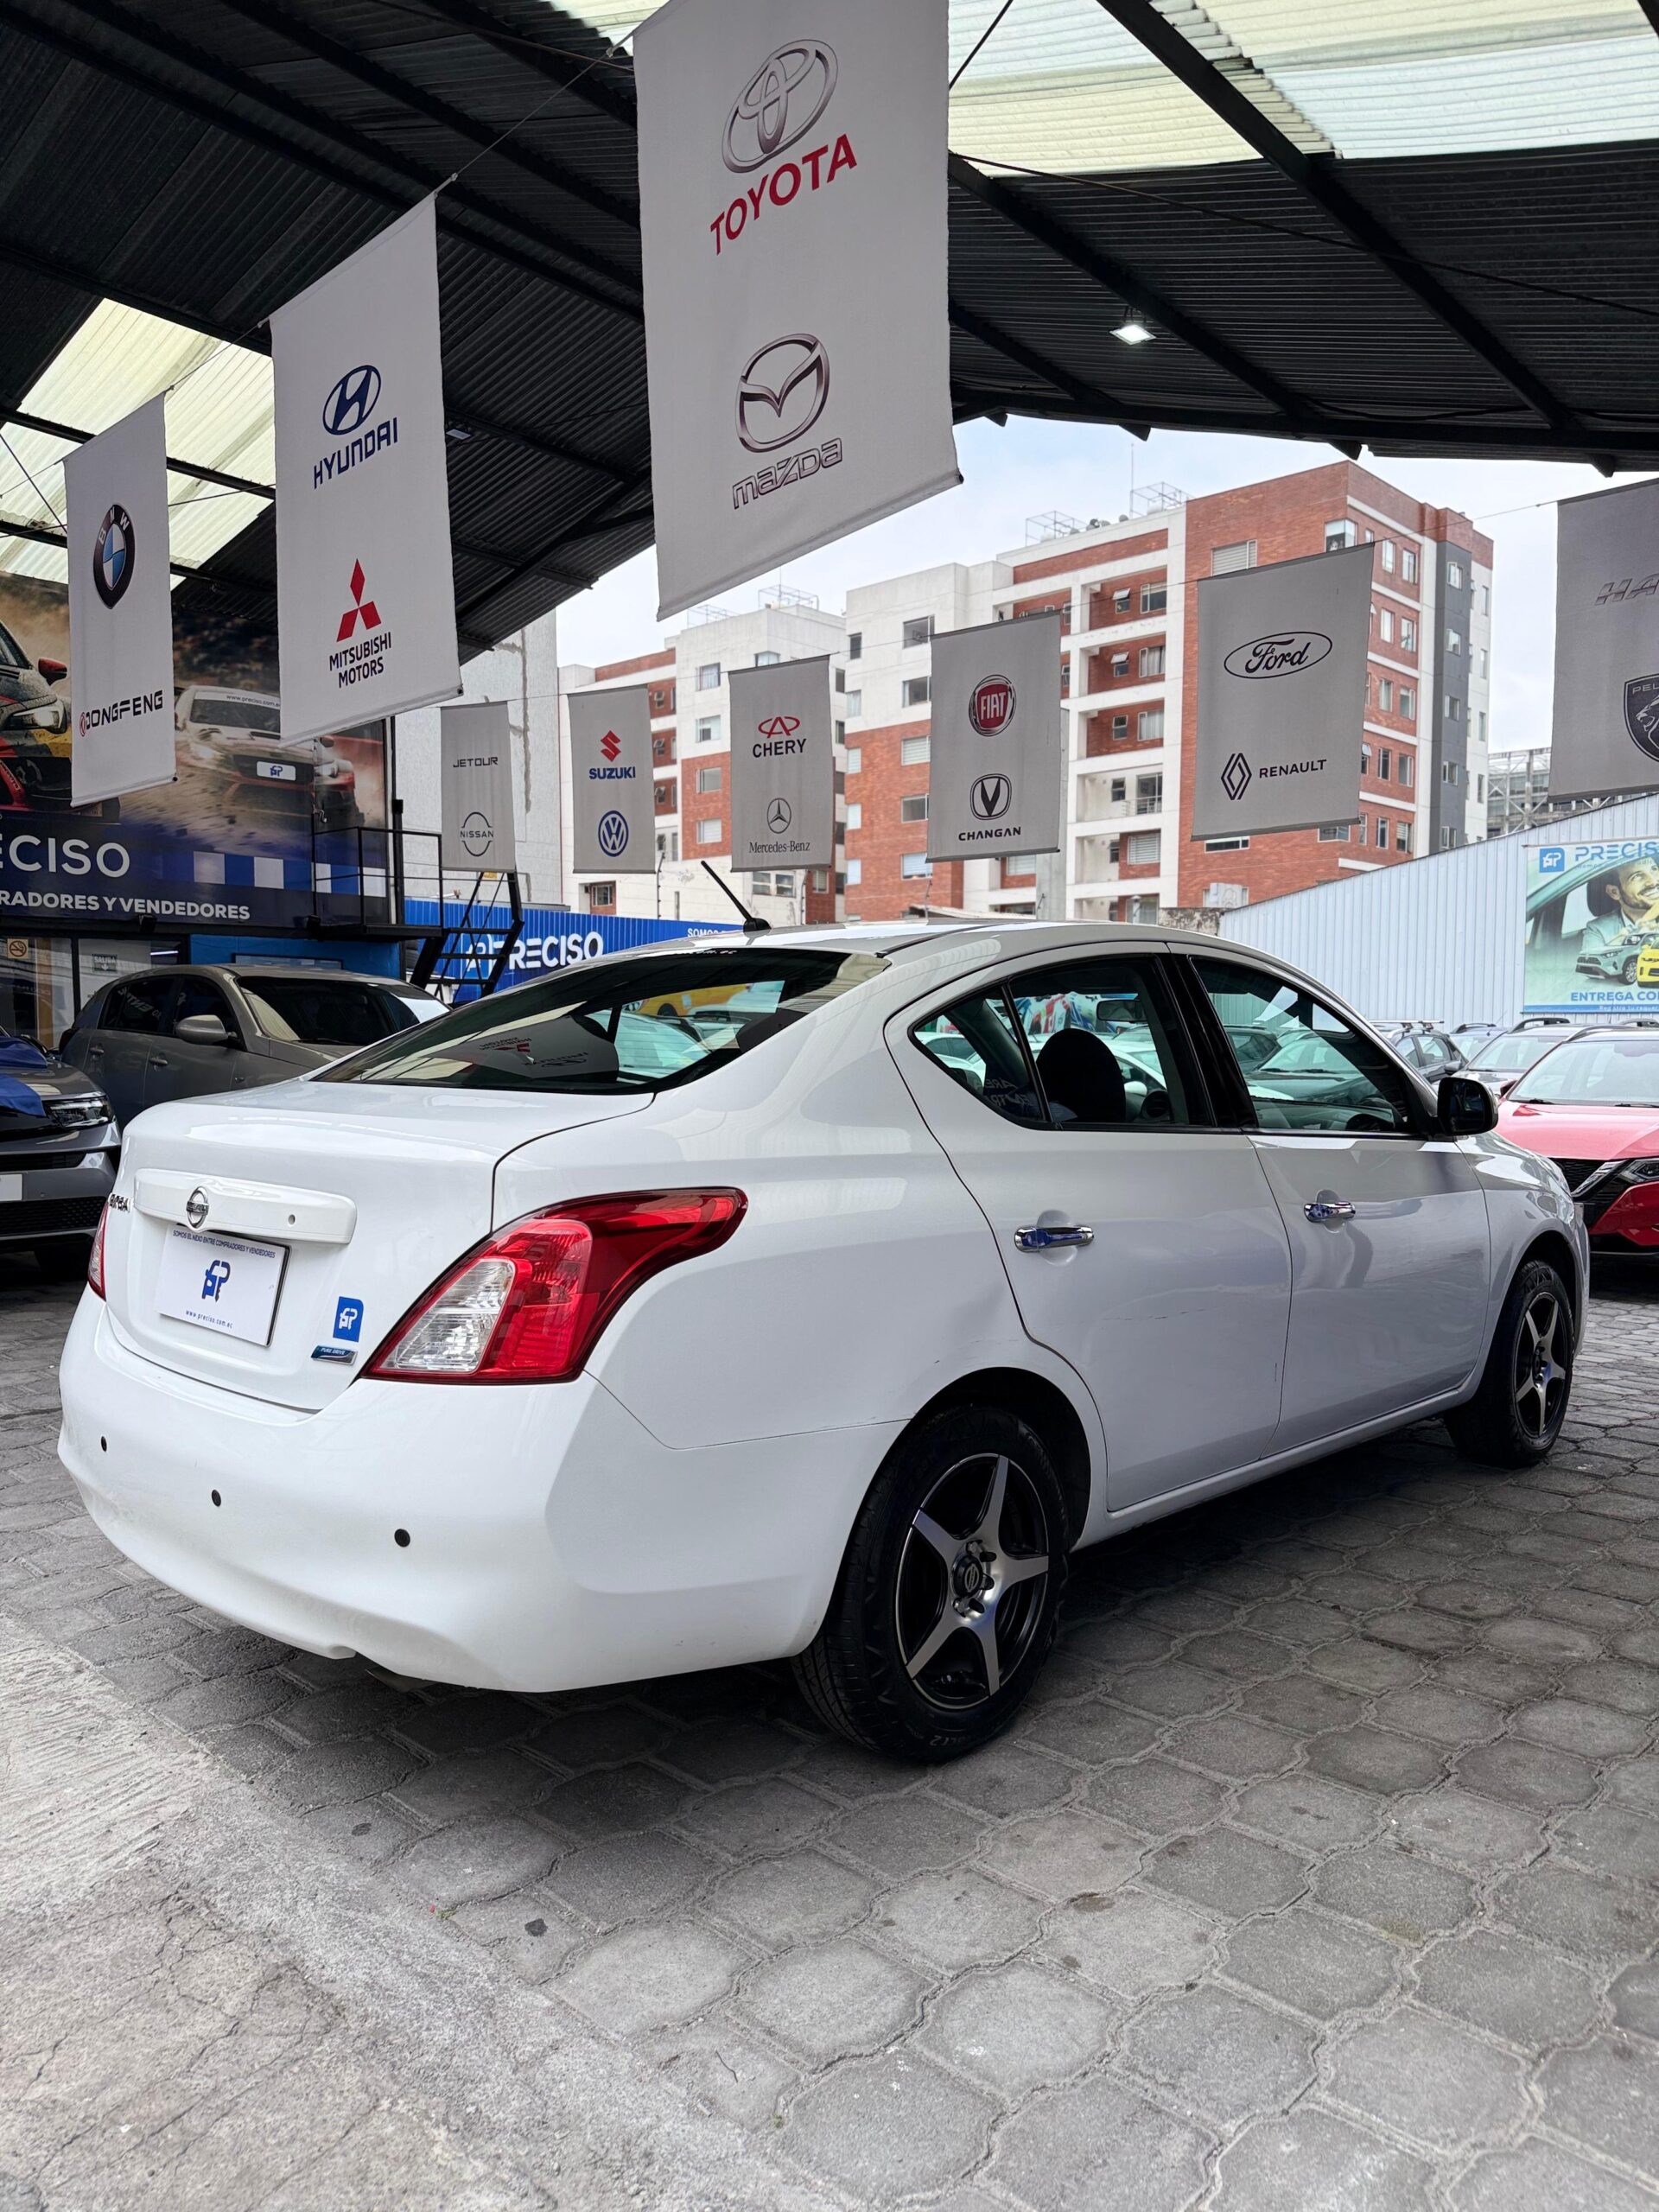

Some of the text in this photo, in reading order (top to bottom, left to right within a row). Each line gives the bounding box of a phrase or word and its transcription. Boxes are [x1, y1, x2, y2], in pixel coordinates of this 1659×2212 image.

[709, 133, 858, 256] TOYOTA
[313, 416, 399, 490] HYUNDAI
[329, 632, 391, 671] MITSUBISHI
[1244, 638, 1312, 674] Ford
[338, 662, 385, 689] MOTORS
[980, 691, 1007, 721] FIAT
[752, 738, 807, 759] CHERY
[452, 756, 499, 769] JETOUR
[588, 766, 636, 780] SUZUKI
[1259, 758, 1328, 779] RENAULT
[460, 830, 494, 839] NISSAN
[958, 825, 1022, 842] CHANGAN
[0, 834, 130, 878] CISO
[748, 840, 811, 854] Mercedes-Benz
[103, 896, 118, 912] Y
[119, 898, 251, 920] VENDEDORES
[1571, 990, 1634, 1002] ENTREGA
[173, 1230, 187, 1238] SOMOS
[203, 1236, 215, 1245] ENTRE
[216, 1239, 245, 1252] COMPRADORES
[249, 1246, 276, 1259] VENDEDORES
[185, 1309, 233, 1329] www.preciso.com.ec
